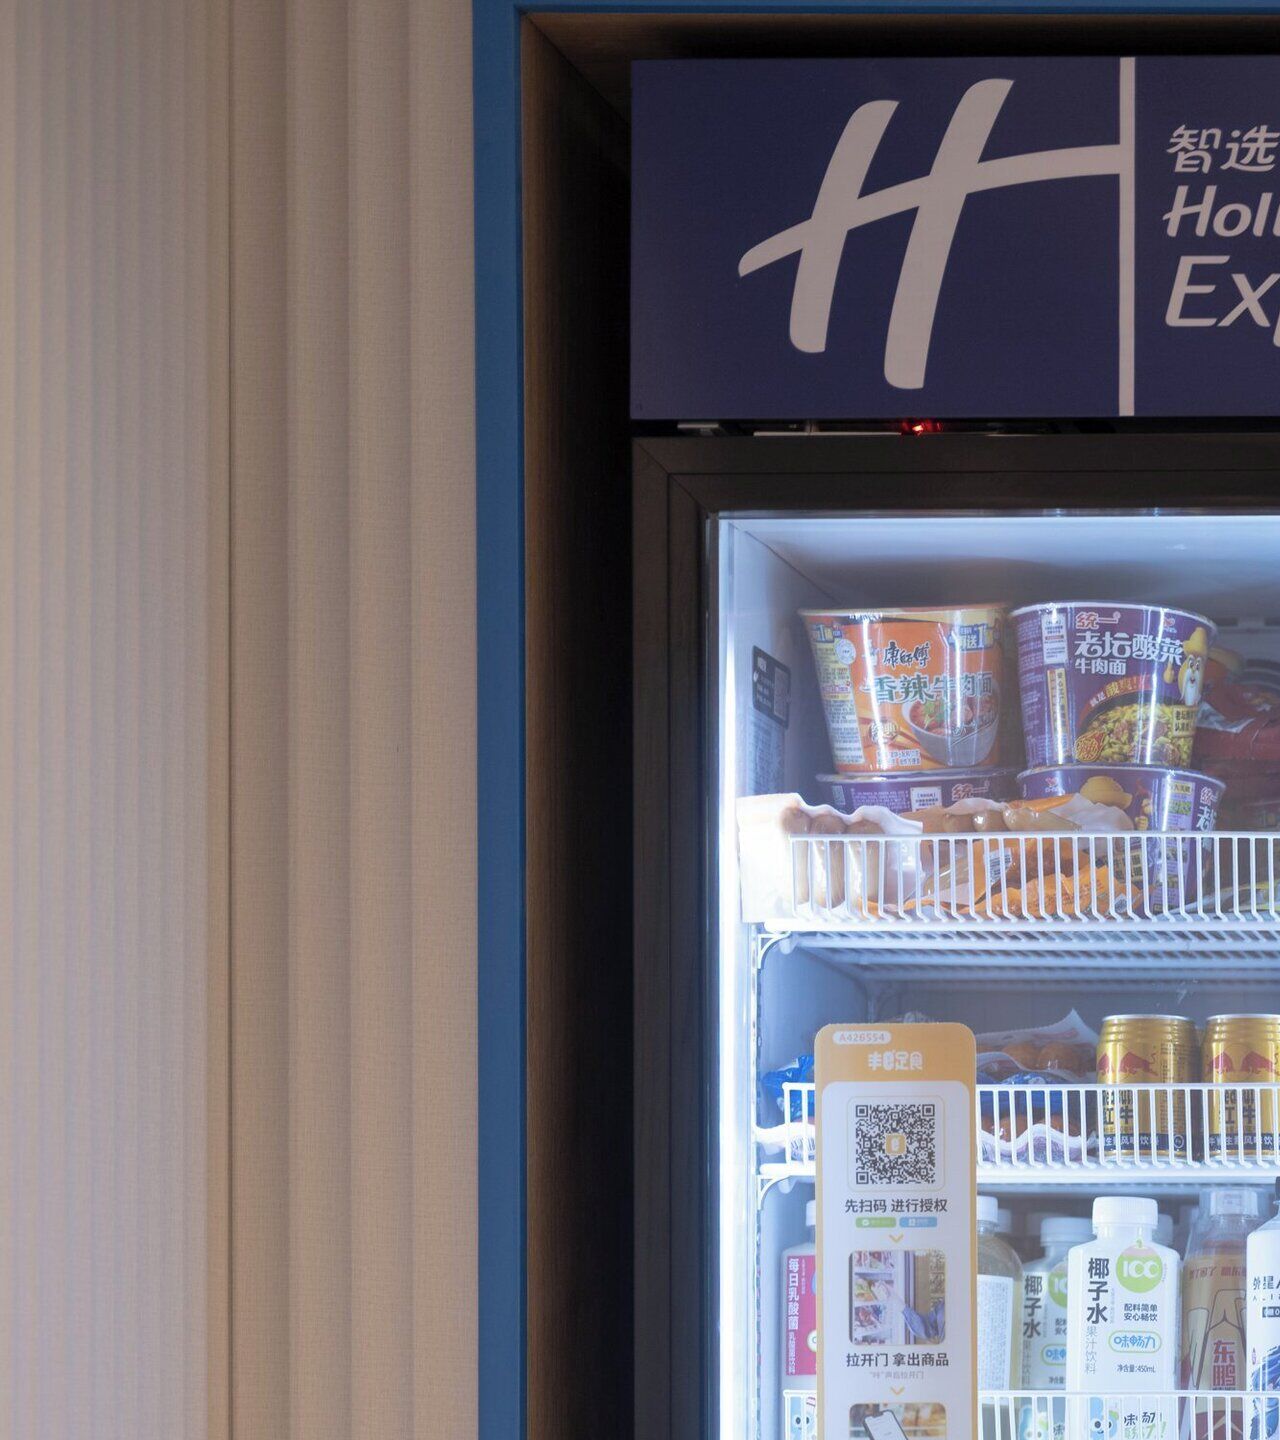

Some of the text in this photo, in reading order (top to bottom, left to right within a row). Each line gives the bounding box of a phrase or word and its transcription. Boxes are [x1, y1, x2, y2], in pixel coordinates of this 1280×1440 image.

[1075, 611, 1119, 630] 统一
[1074, 631, 1184, 666] 老坛酸菜
[1074, 658, 1127, 676] 牛肉面
[839, 1032, 886, 1042] A426554
[845, 1199, 948, 1213] 先扫码 进行授权
[788, 1258, 800, 1330] 每日乳酸菌
[1087, 1257, 1110, 1325] 椰子水
[1023, 1276, 1043, 1339] 椰子水
[1124, 1303, 1158, 1312] 配料简单
[1123, 1313, 1158, 1322] 安心畅饮
[846, 1353, 949, 1367] 拉开门 拿出商品
